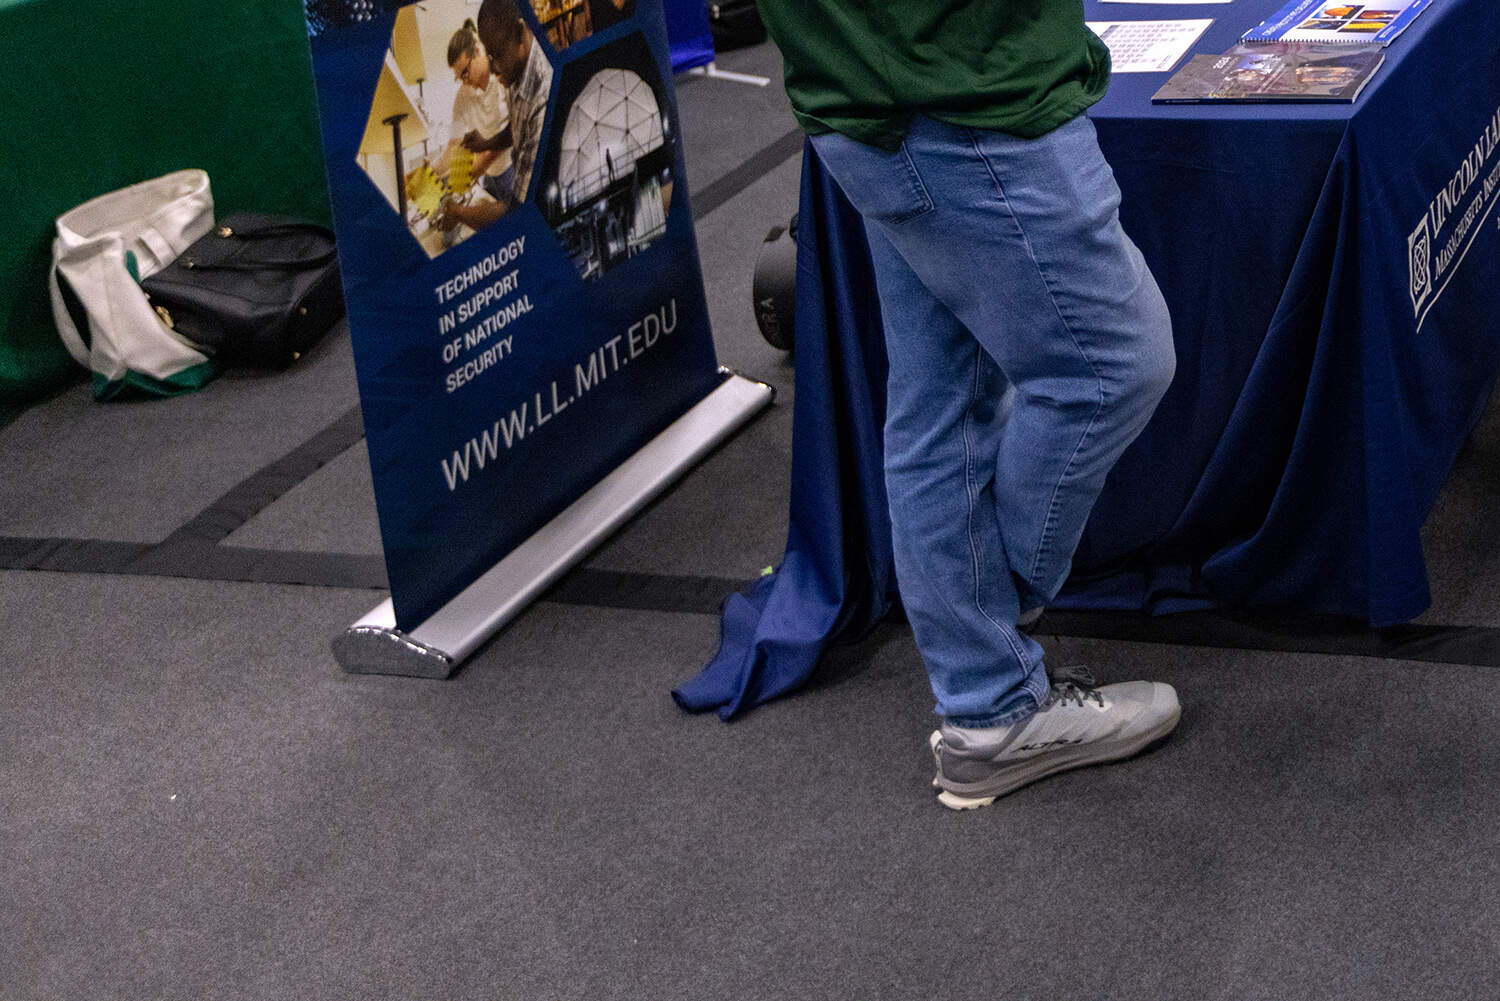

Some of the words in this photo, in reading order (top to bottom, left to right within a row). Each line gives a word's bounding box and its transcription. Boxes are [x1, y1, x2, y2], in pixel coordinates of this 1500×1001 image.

[1429, 136, 1484, 240] LINCOLN
[435, 235, 526, 304] TECHNOLOGY
[438, 311, 456, 335] IN
[458, 269, 520, 324] SUPPORT
[442, 338, 463, 364] OF
[464, 294, 535, 351] NATIONAL
[446, 334, 514, 393] SECURITY
[441, 298, 678, 492] WWW.LL.MIT.EDU
